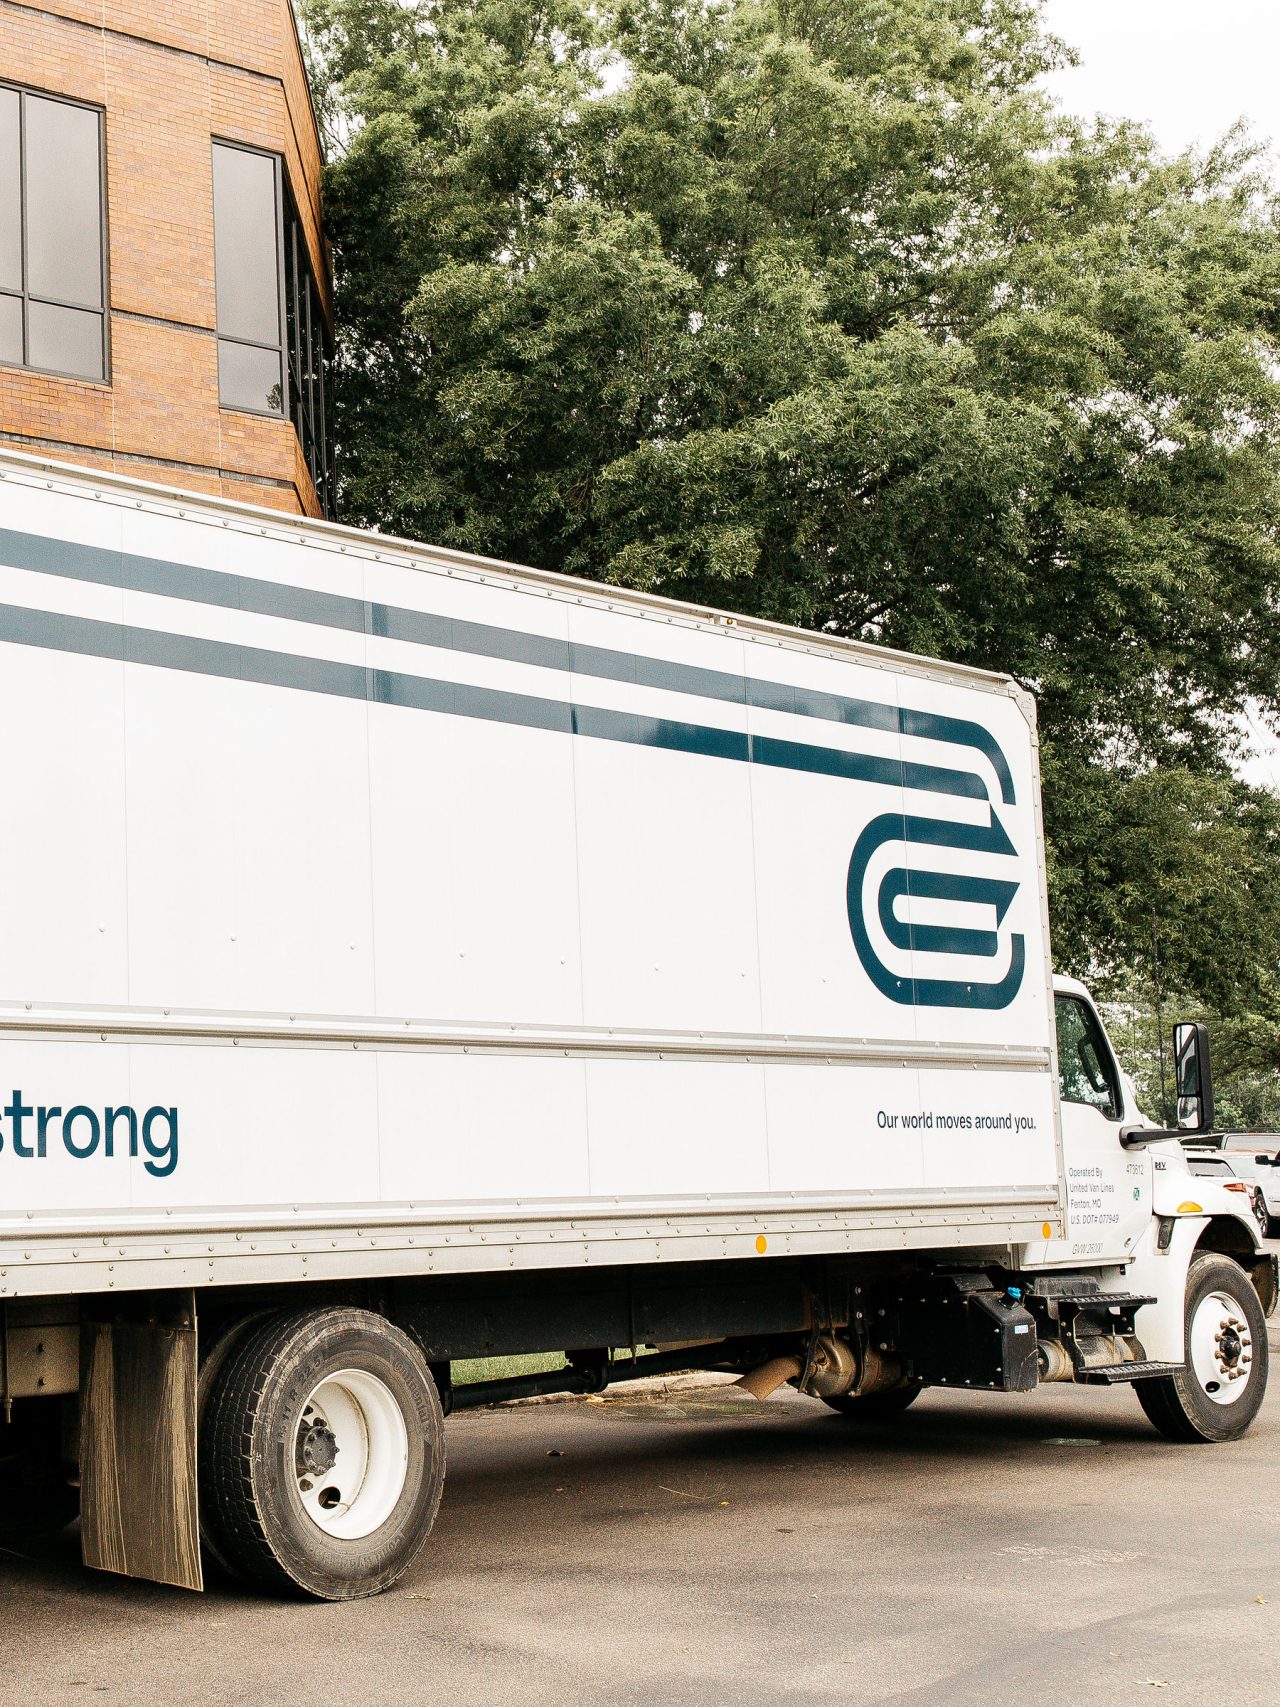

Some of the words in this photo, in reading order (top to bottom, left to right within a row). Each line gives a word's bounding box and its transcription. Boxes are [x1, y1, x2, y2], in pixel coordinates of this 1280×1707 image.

[877, 1111, 899, 1129] Our
[901, 1111, 933, 1129] world
[936, 1115, 972, 1129] moves
[975, 1113, 1012, 1129] around
[1015, 1116, 1037, 1133] you.
[1068, 1167, 1094, 1178] Operated
[1095, 1168, 1103, 1179] By
[1126, 1164, 1144, 1175] 473612
[1069, 1184, 1088, 1192] United
[1089, 1184, 1100, 1192] Van
[1101, 1184, 1115, 1192] Lines
[1070, 1199, 1091, 1210] Fenton,
[1092, 1199, 1102, 1208] MO
[1071, 1216, 1081, 1224] U.S.
[1082, 1215, 1098, 1224] DOT#
[1099, 1214, 1120, 1224] 077949
